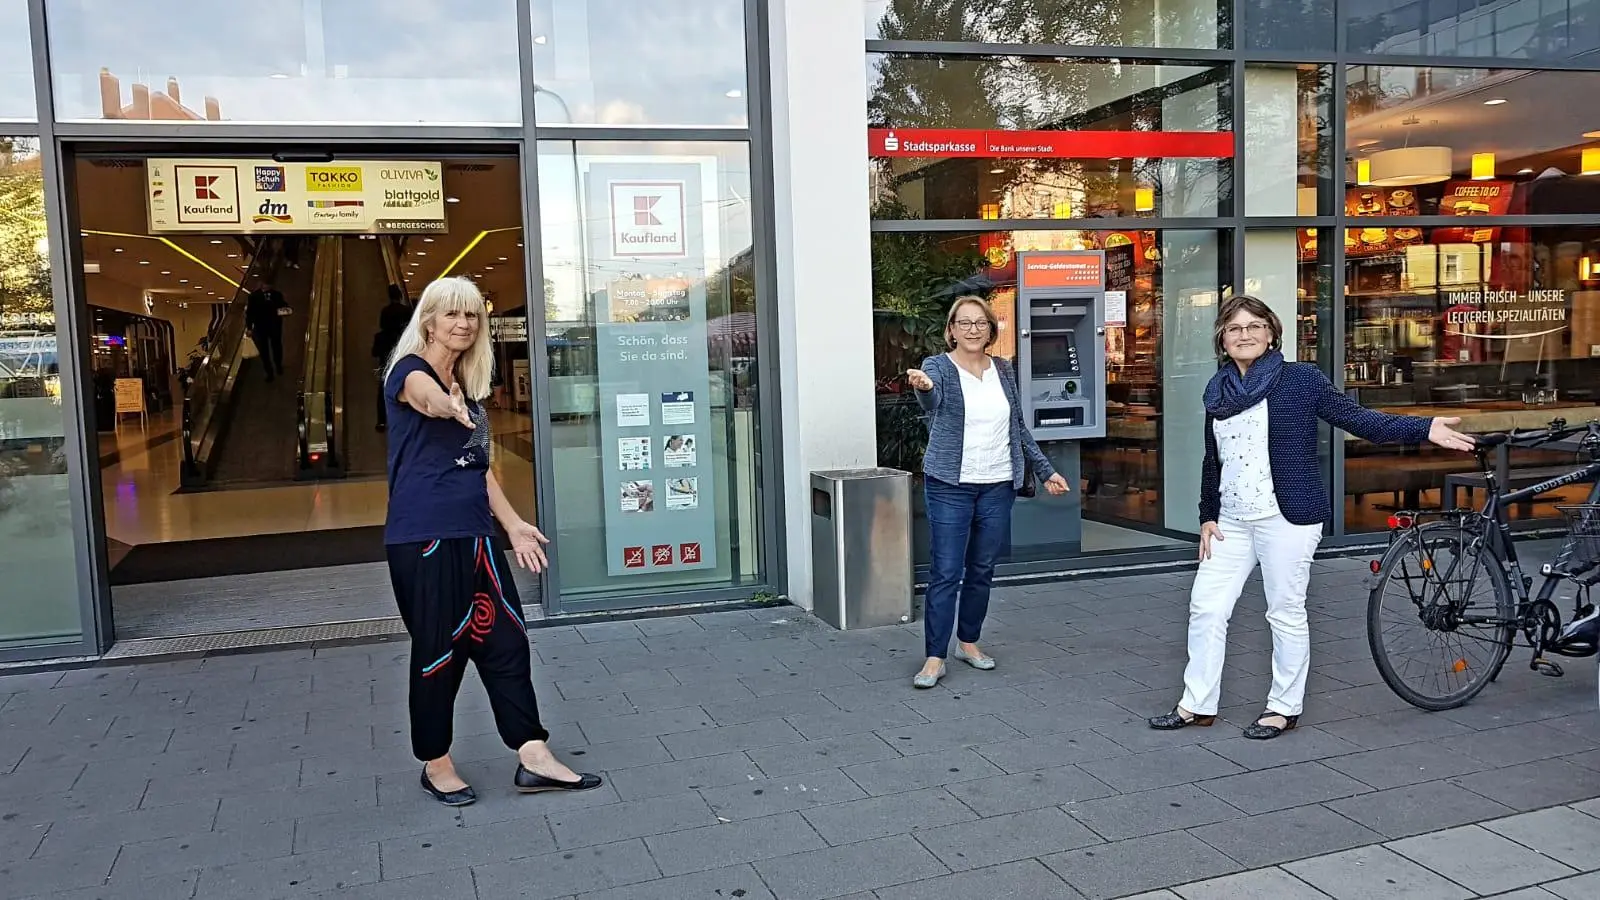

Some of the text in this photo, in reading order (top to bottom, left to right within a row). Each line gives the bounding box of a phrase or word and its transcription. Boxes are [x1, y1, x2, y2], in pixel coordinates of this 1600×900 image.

[903, 140, 976, 153] Stadtsparkasse
[256, 168, 281, 176] Happy
[380, 169, 424, 180] OLIVIVA
[256, 175, 280, 183] Schuh
[385, 189, 440, 202] blattgold
[1454, 186, 1479, 197] COFFEE
[1479, 186, 1489, 196] TO
[184, 205, 233, 214] Kaufland
[259, 199, 288, 215] dm
[621, 232, 677, 244] Kaufland
[616, 289, 646, 298] Montag
[1448, 290, 1481, 304] IMMER
[1484, 289, 1517, 303] FRISCH
[1529, 289, 1565, 303] UNSERE
[1447, 307, 1565, 324] LECKEREN SPEZIALITÄTEN
[617, 334, 688, 347] Schön, dass
[620, 349, 688, 362] Sie da sind.
[1534, 469, 1588, 492] GUDEREIT
